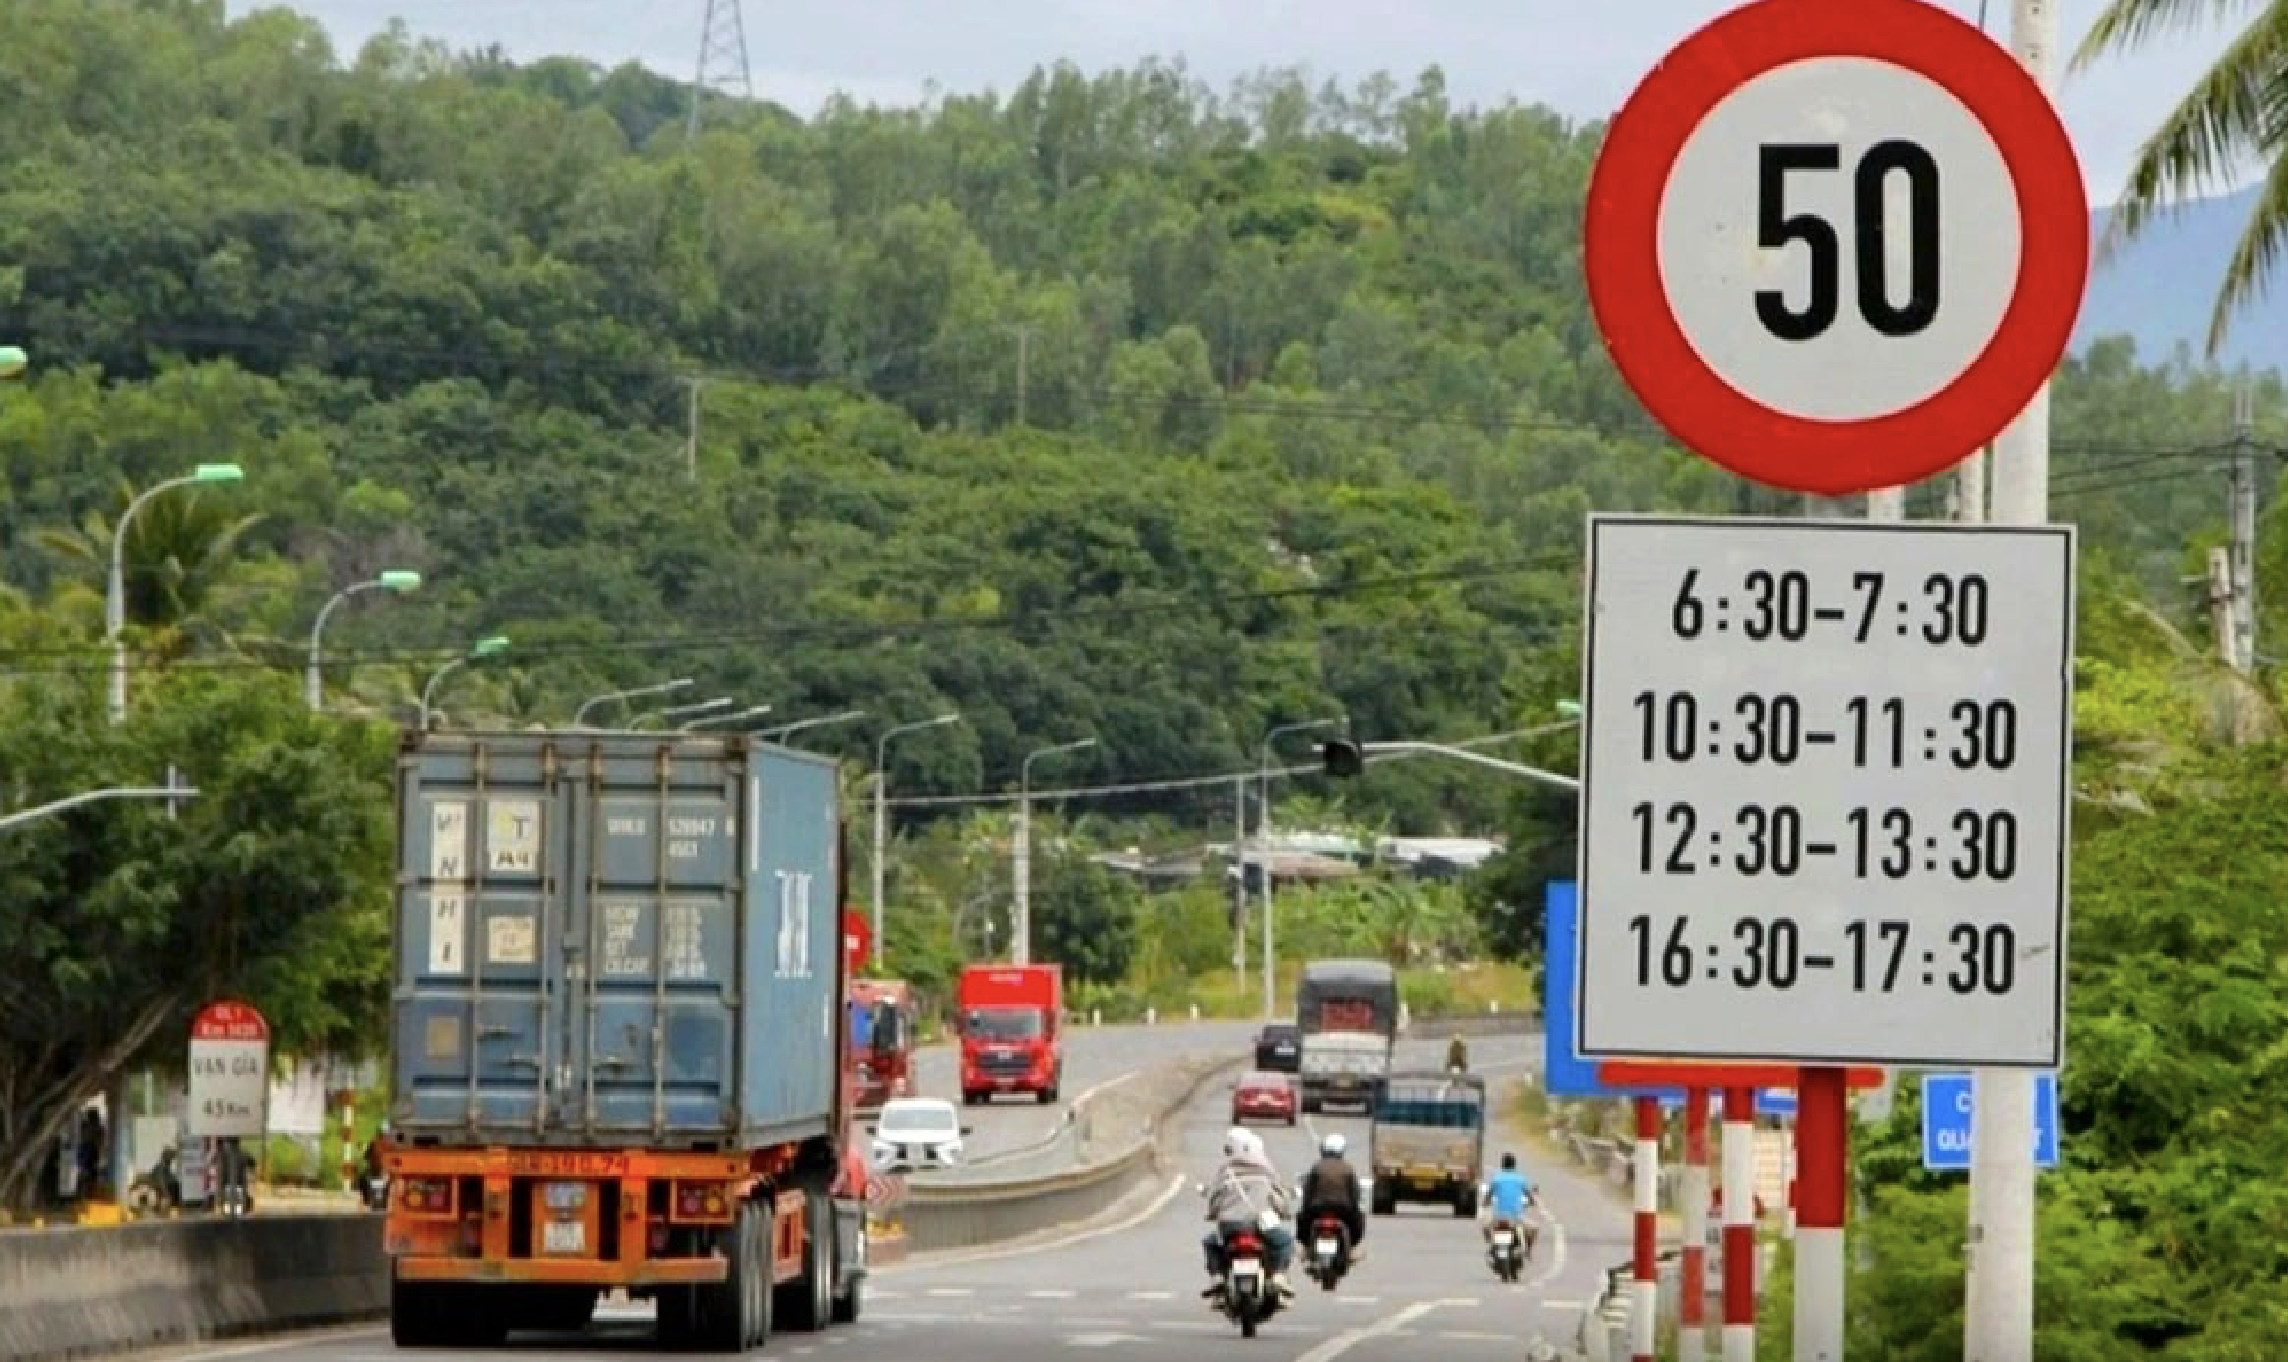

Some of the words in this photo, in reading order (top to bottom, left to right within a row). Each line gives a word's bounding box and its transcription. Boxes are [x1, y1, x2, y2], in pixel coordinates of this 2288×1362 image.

[1754, 139, 1941, 341] 50
[1671, 568, 1989, 647] 6:30-7:30
[1633, 691, 2017, 770] 10:30-11:30
[1632, 801, 2017, 882] 12:30-13:30
[1628, 914, 2016, 995] 16:30-17:30
